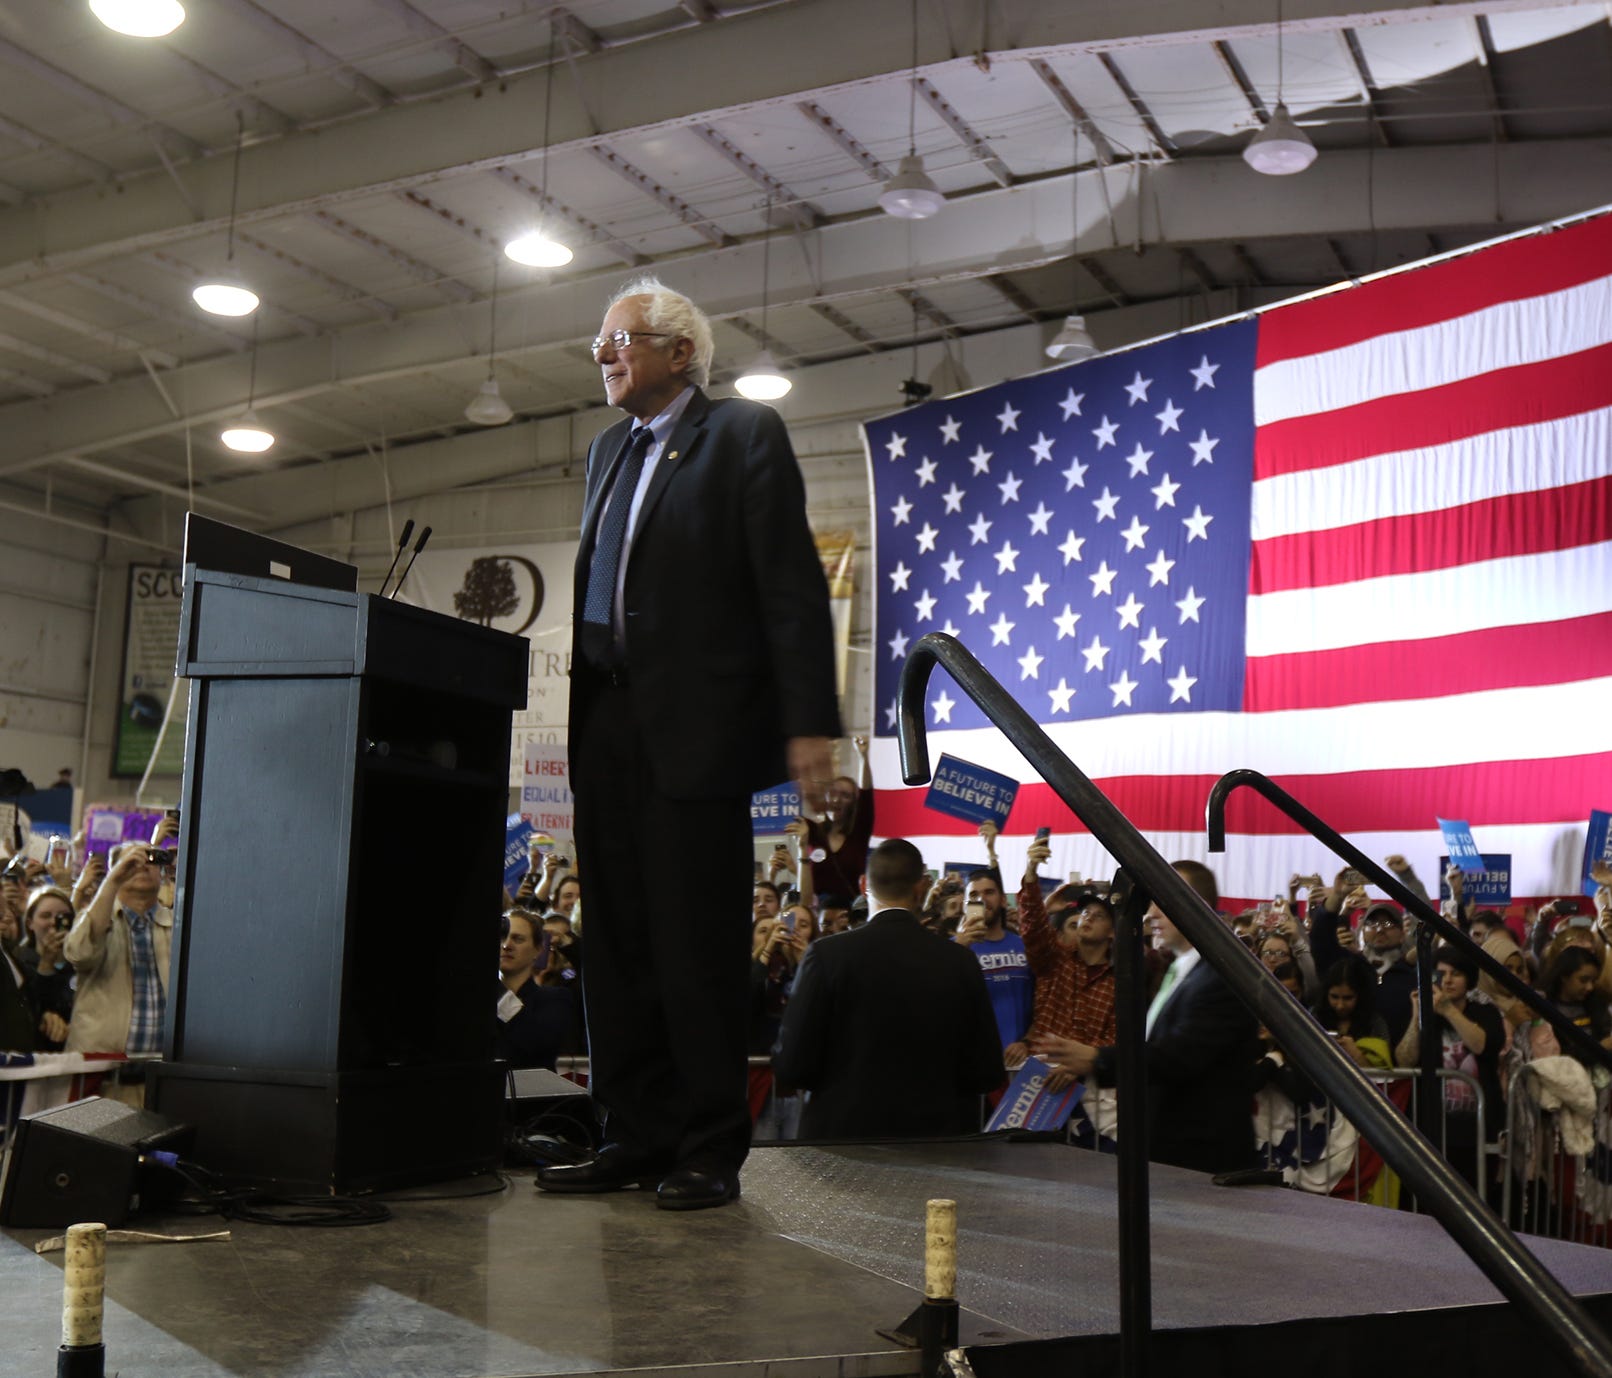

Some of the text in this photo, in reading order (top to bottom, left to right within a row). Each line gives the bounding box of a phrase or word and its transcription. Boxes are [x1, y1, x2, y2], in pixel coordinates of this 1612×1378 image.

[939, 767, 1014, 803] A FUTURE TO
[781, 793, 800, 804] TO
[933, 778, 995, 809] BELIEVE
[995, 800, 1011, 817] IN
[782, 805, 800, 817] IN
[1458, 833, 1473, 845] TO
[1500, 883, 1508, 894] A
[979, 950, 1027, 970] ernie
